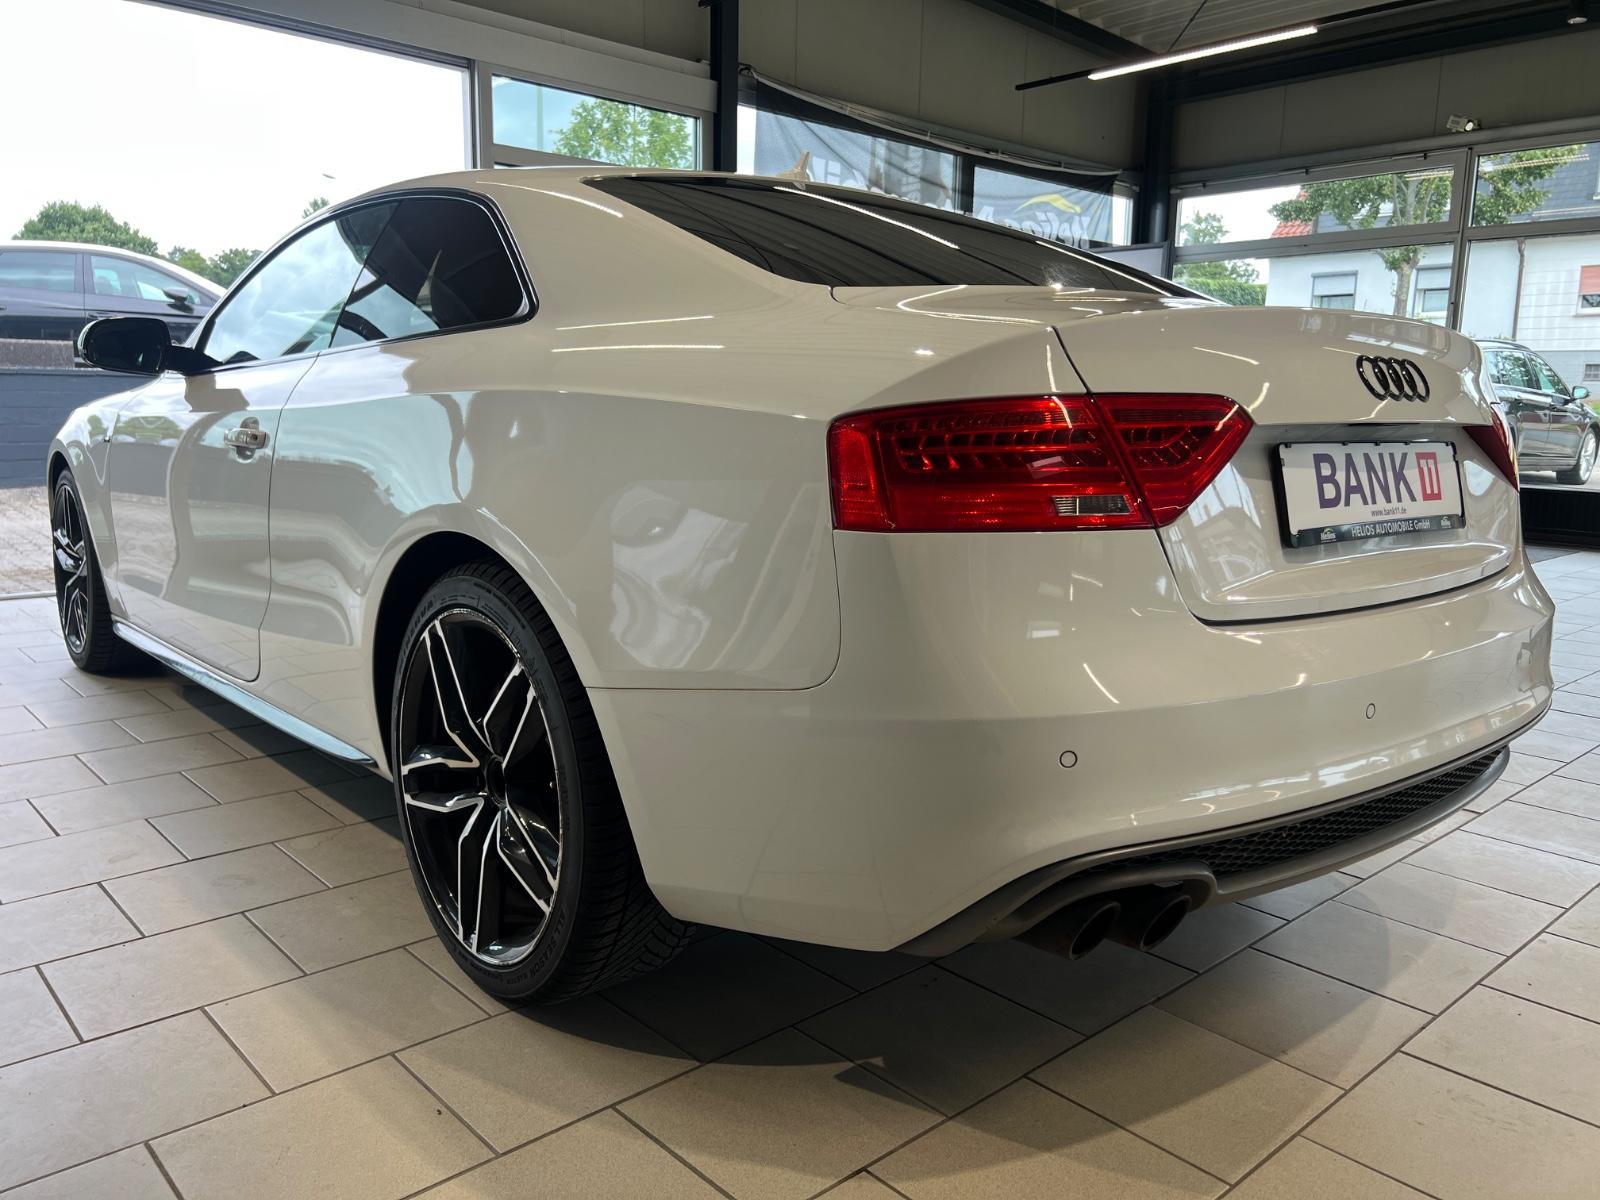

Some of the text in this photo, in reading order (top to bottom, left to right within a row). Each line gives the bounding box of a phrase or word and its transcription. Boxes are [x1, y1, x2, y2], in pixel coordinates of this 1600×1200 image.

[1313, 452, 1439, 509] BANK 11
[1371, 507, 1407, 517] www.bank11.de
[1351, 519, 1431, 537] HELIOS AUTOMOBILE GmbH
[1320, 531, 1336, 541] Helios
